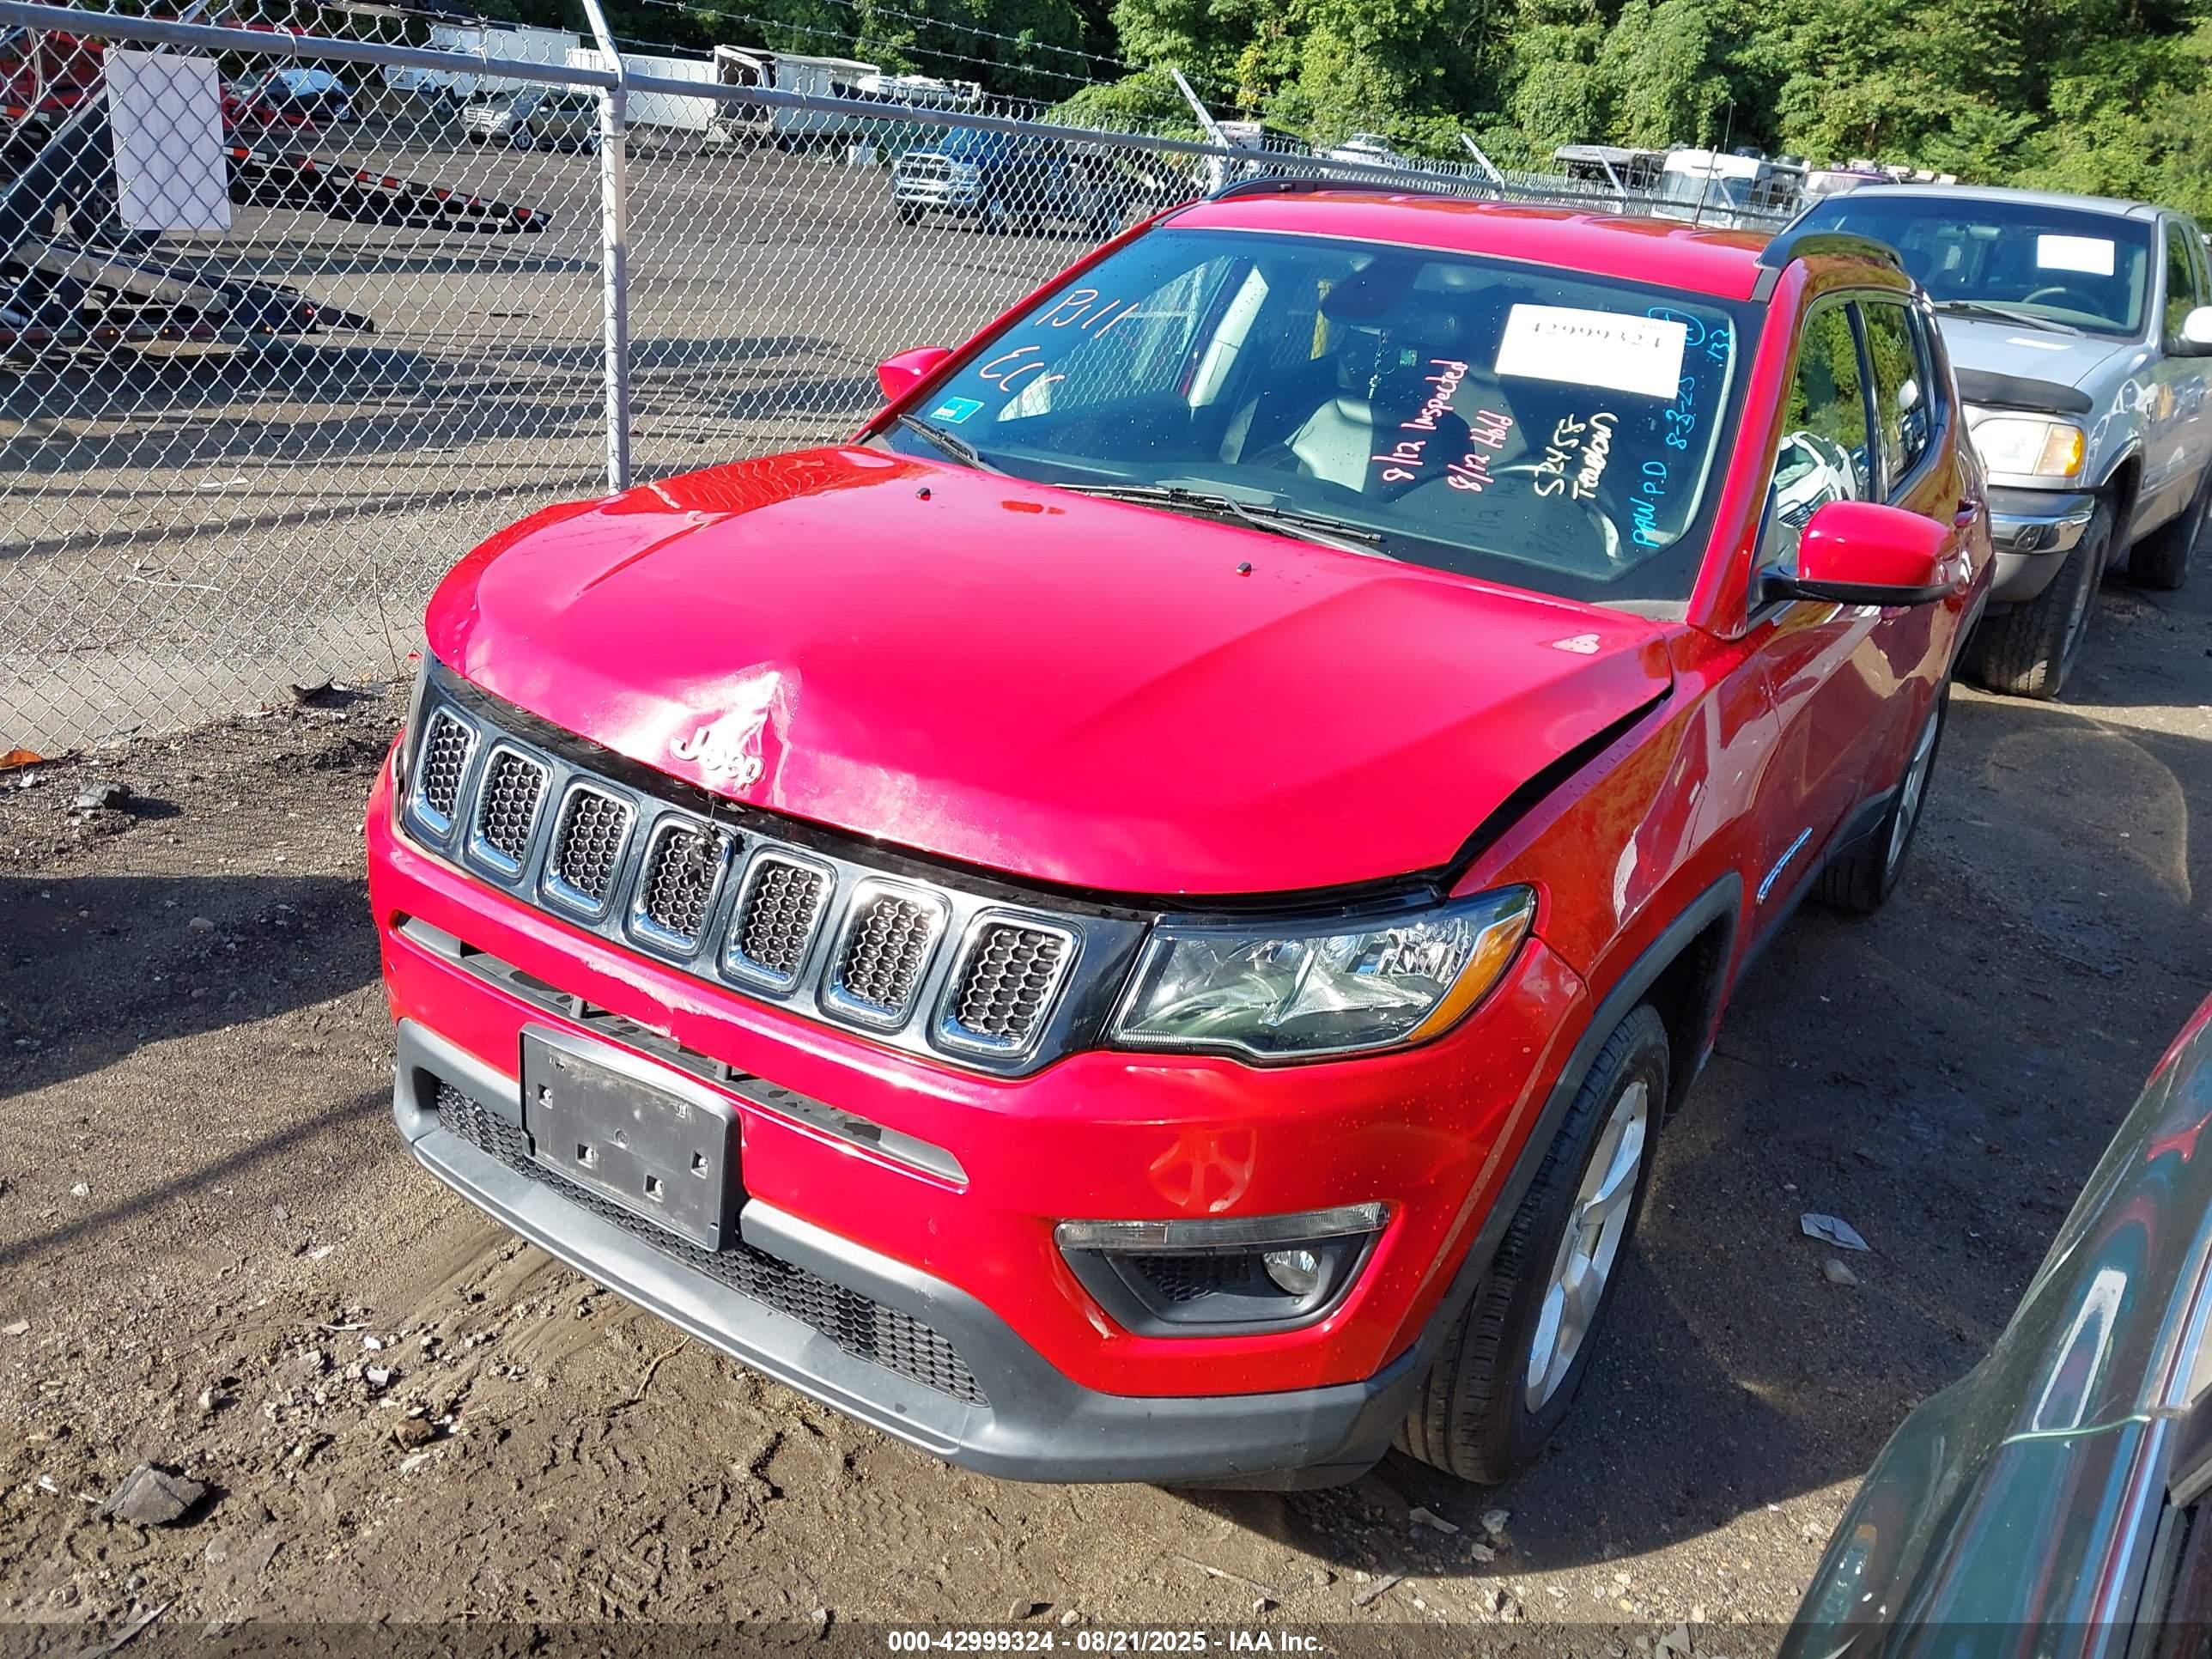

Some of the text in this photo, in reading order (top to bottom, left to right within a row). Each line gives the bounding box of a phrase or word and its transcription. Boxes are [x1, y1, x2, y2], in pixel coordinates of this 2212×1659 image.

[1371, 358, 1469, 482] 8/12 Inspected
[1469, 409, 1515, 451] Hold
[1447, 452, 1494, 494] 8/12
